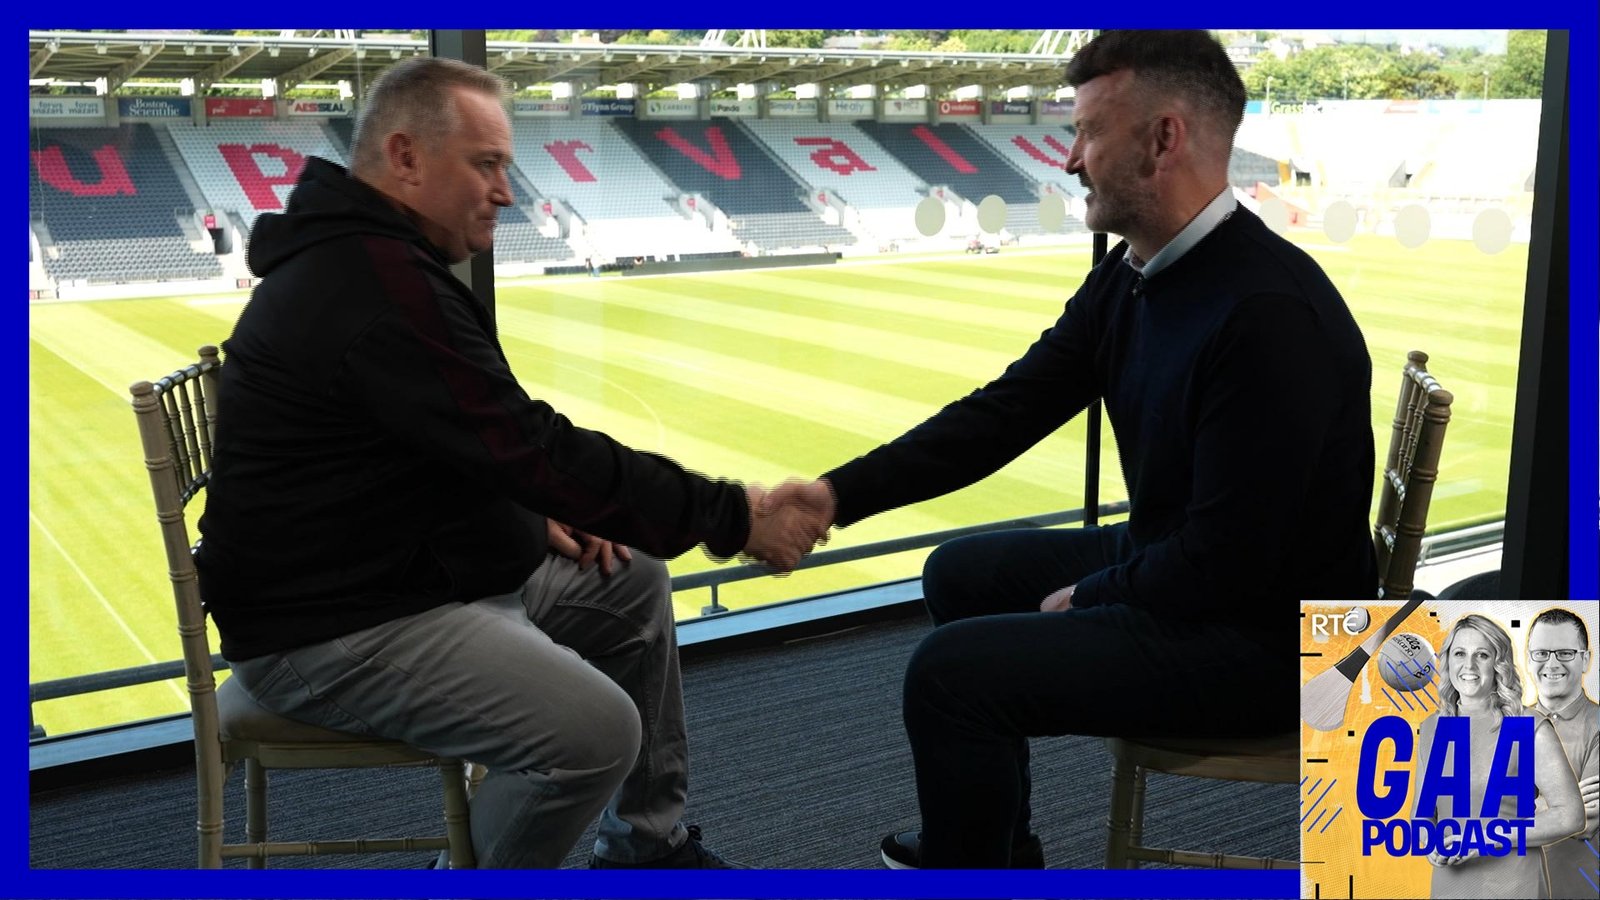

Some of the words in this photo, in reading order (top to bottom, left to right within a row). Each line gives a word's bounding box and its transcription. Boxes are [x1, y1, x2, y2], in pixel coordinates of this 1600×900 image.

[135, 98, 168, 108] Boston
[294, 103, 346, 113] AESSEAL
[611, 102, 634, 113] Group
[717, 104, 740, 112] Panda
[835, 101, 865, 112] Healy
[129, 104, 180, 117] Scientific
[212, 107, 226, 115] pwc
[249, 107, 262, 115] pwc
